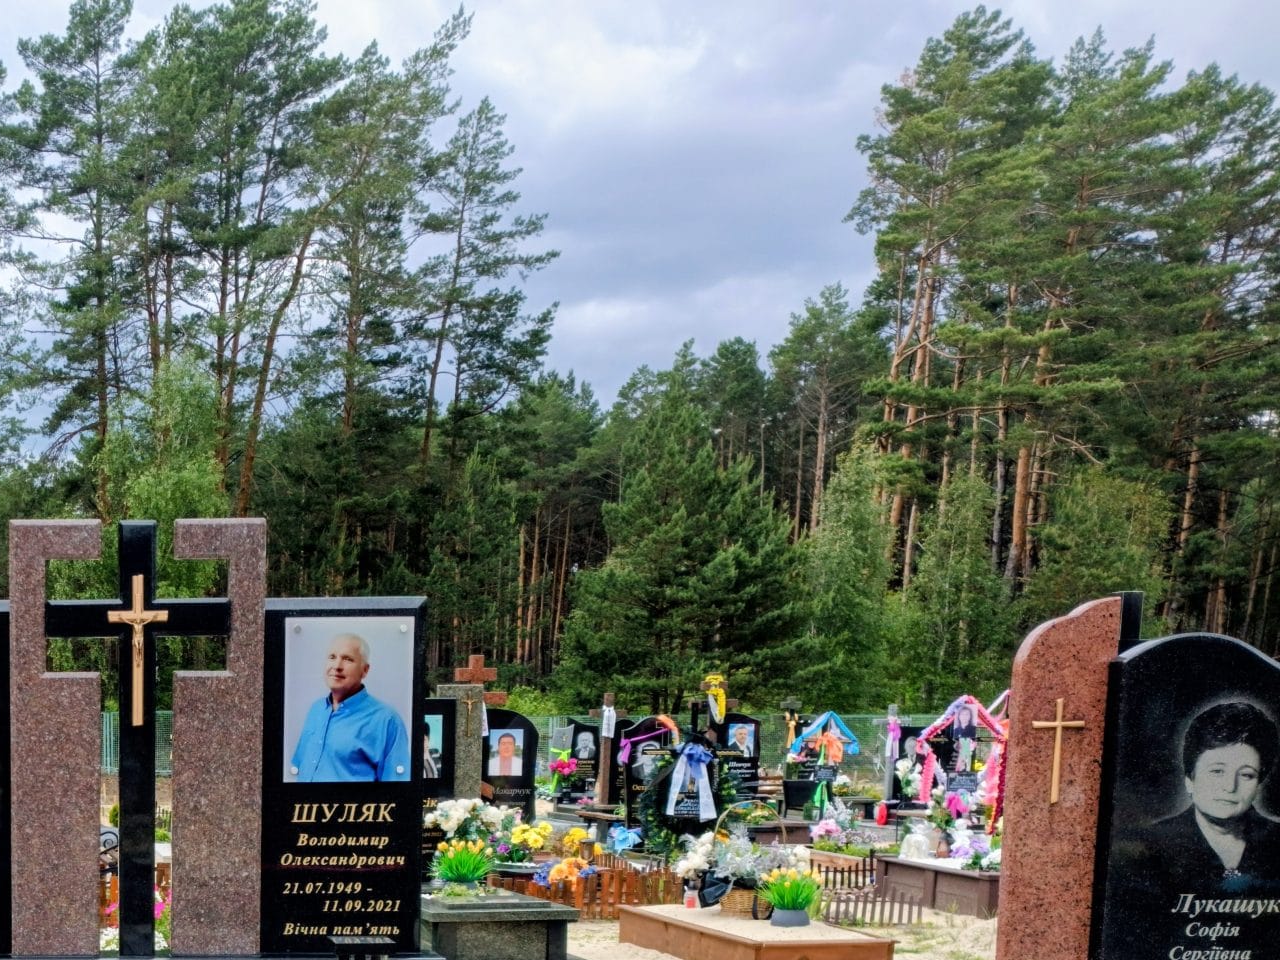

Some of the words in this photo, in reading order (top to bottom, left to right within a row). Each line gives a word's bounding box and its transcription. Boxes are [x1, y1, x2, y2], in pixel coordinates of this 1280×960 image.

[291, 803, 396, 823] ШУЛЯК
[297, 833, 389, 848] Володимир
[280, 853, 405, 868] Олександрович
[282, 882, 362, 894] 21.07.1949
[323, 900, 401, 912] 11.09.2021
[1171, 893, 1280, 919] Лукашук
[283, 922, 327, 936] Вічна
[1185, 922, 1241, 941] Софія
